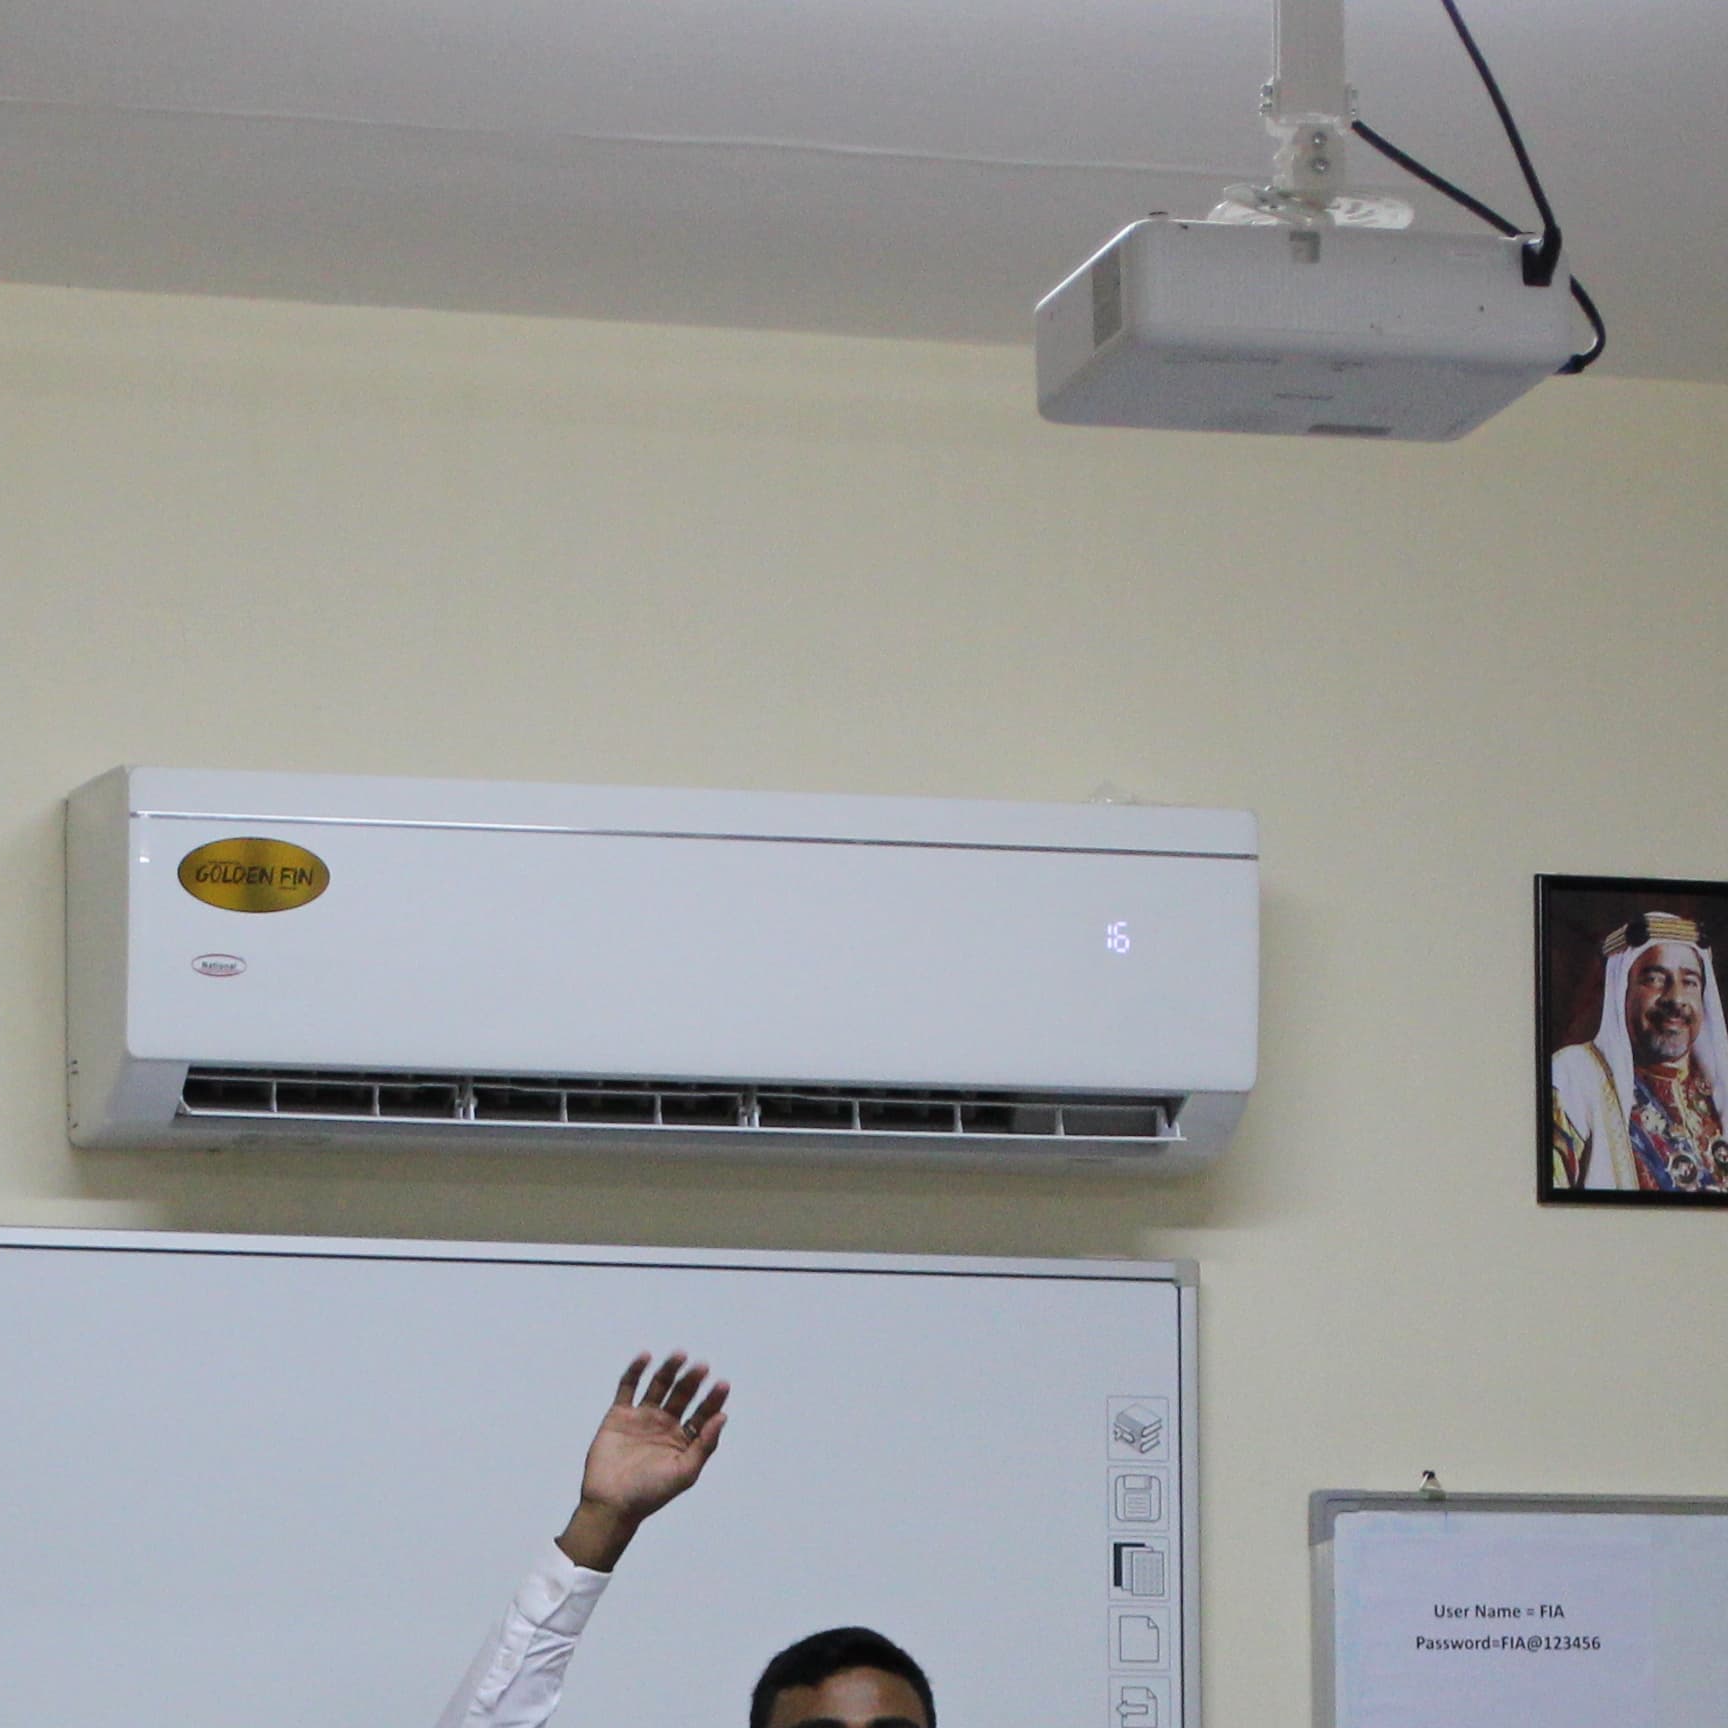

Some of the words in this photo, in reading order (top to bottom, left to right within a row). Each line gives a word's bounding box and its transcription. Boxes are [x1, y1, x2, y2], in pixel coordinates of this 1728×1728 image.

[195, 864, 274, 886] GOLDEN
[280, 866, 314, 887] FIN
[1106, 921, 1131, 953] 16
[1433, 1604, 1470, 1618] User
[1475, 1604, 1521, 1618] Name
[1539, 1604, 1565, 1618] FIA
[1415, 1635, 1602, 1653] Password=FIA@123456
